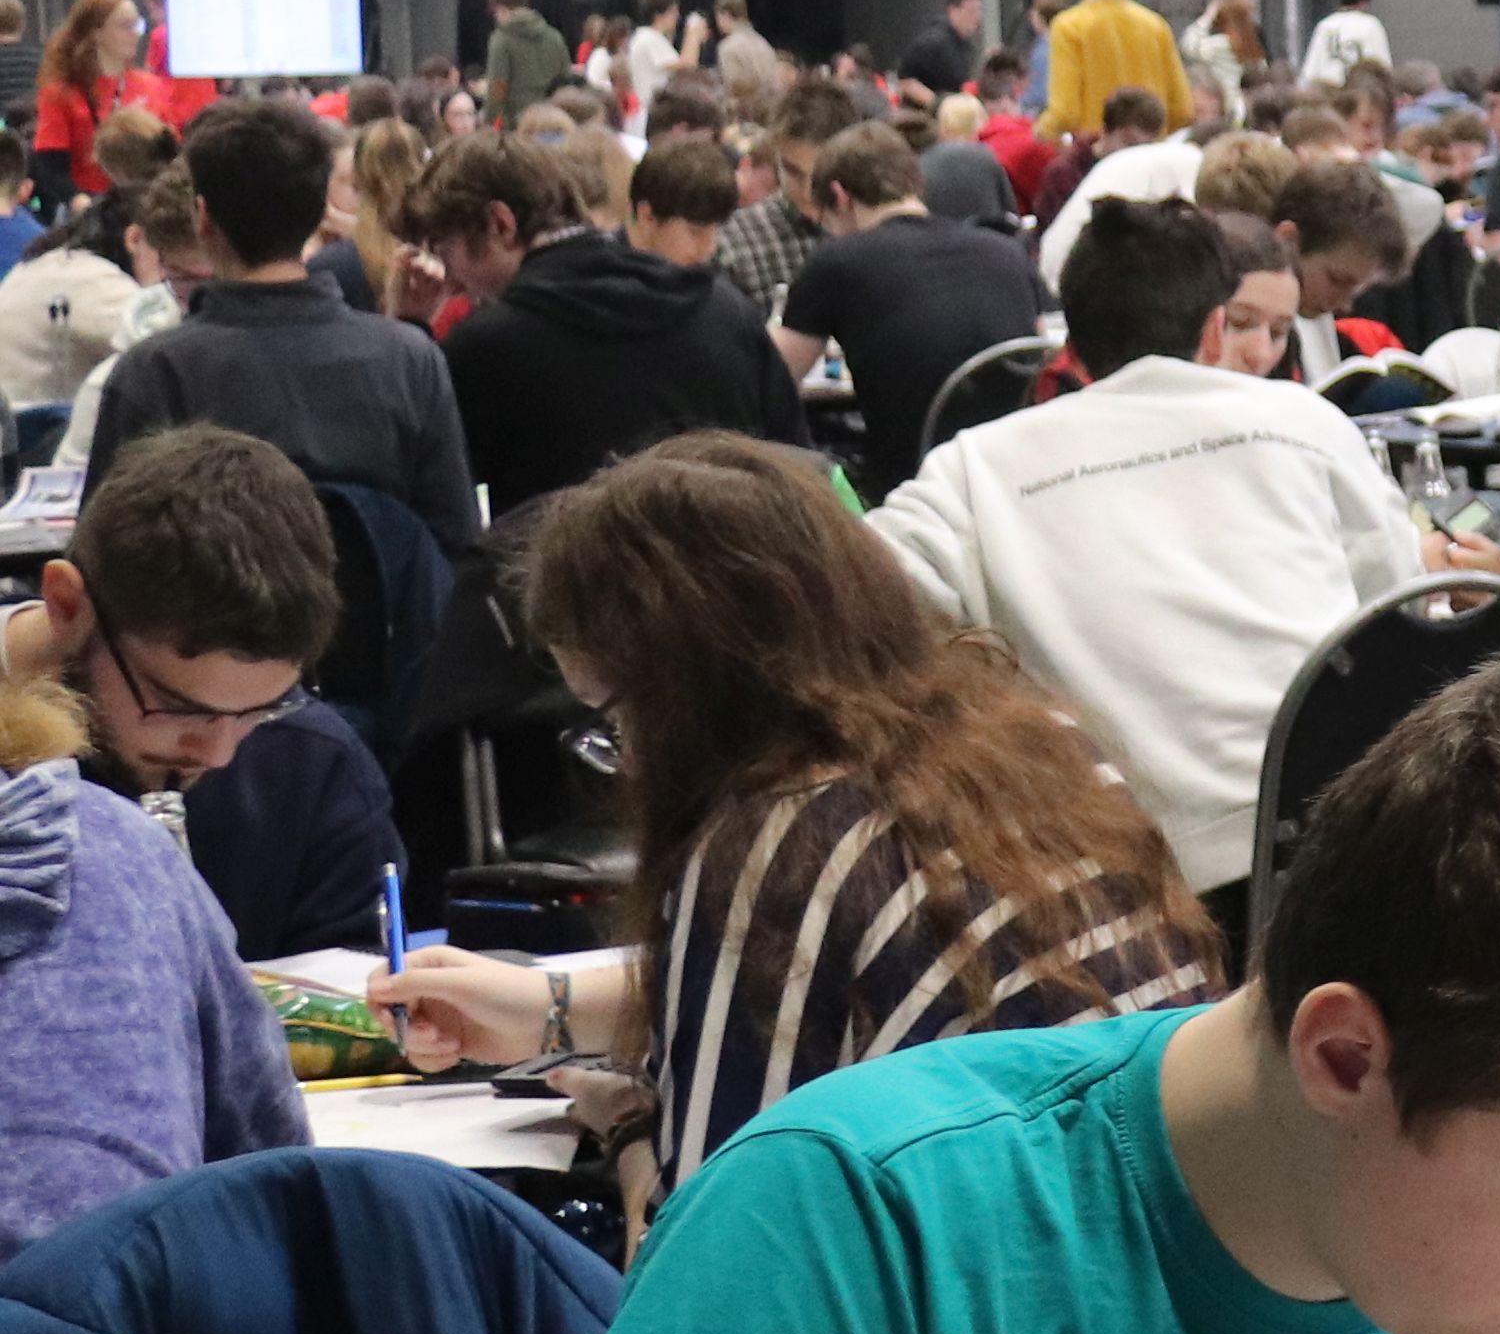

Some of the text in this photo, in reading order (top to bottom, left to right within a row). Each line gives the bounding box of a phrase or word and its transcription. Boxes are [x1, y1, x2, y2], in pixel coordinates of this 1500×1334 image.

[1019, 467, 1075, 498] National
[1079, 450, 1167, 479] Aeronautics
[1170, 441, 1198, 460] and
[1201, 430, 1248, 454] Space
